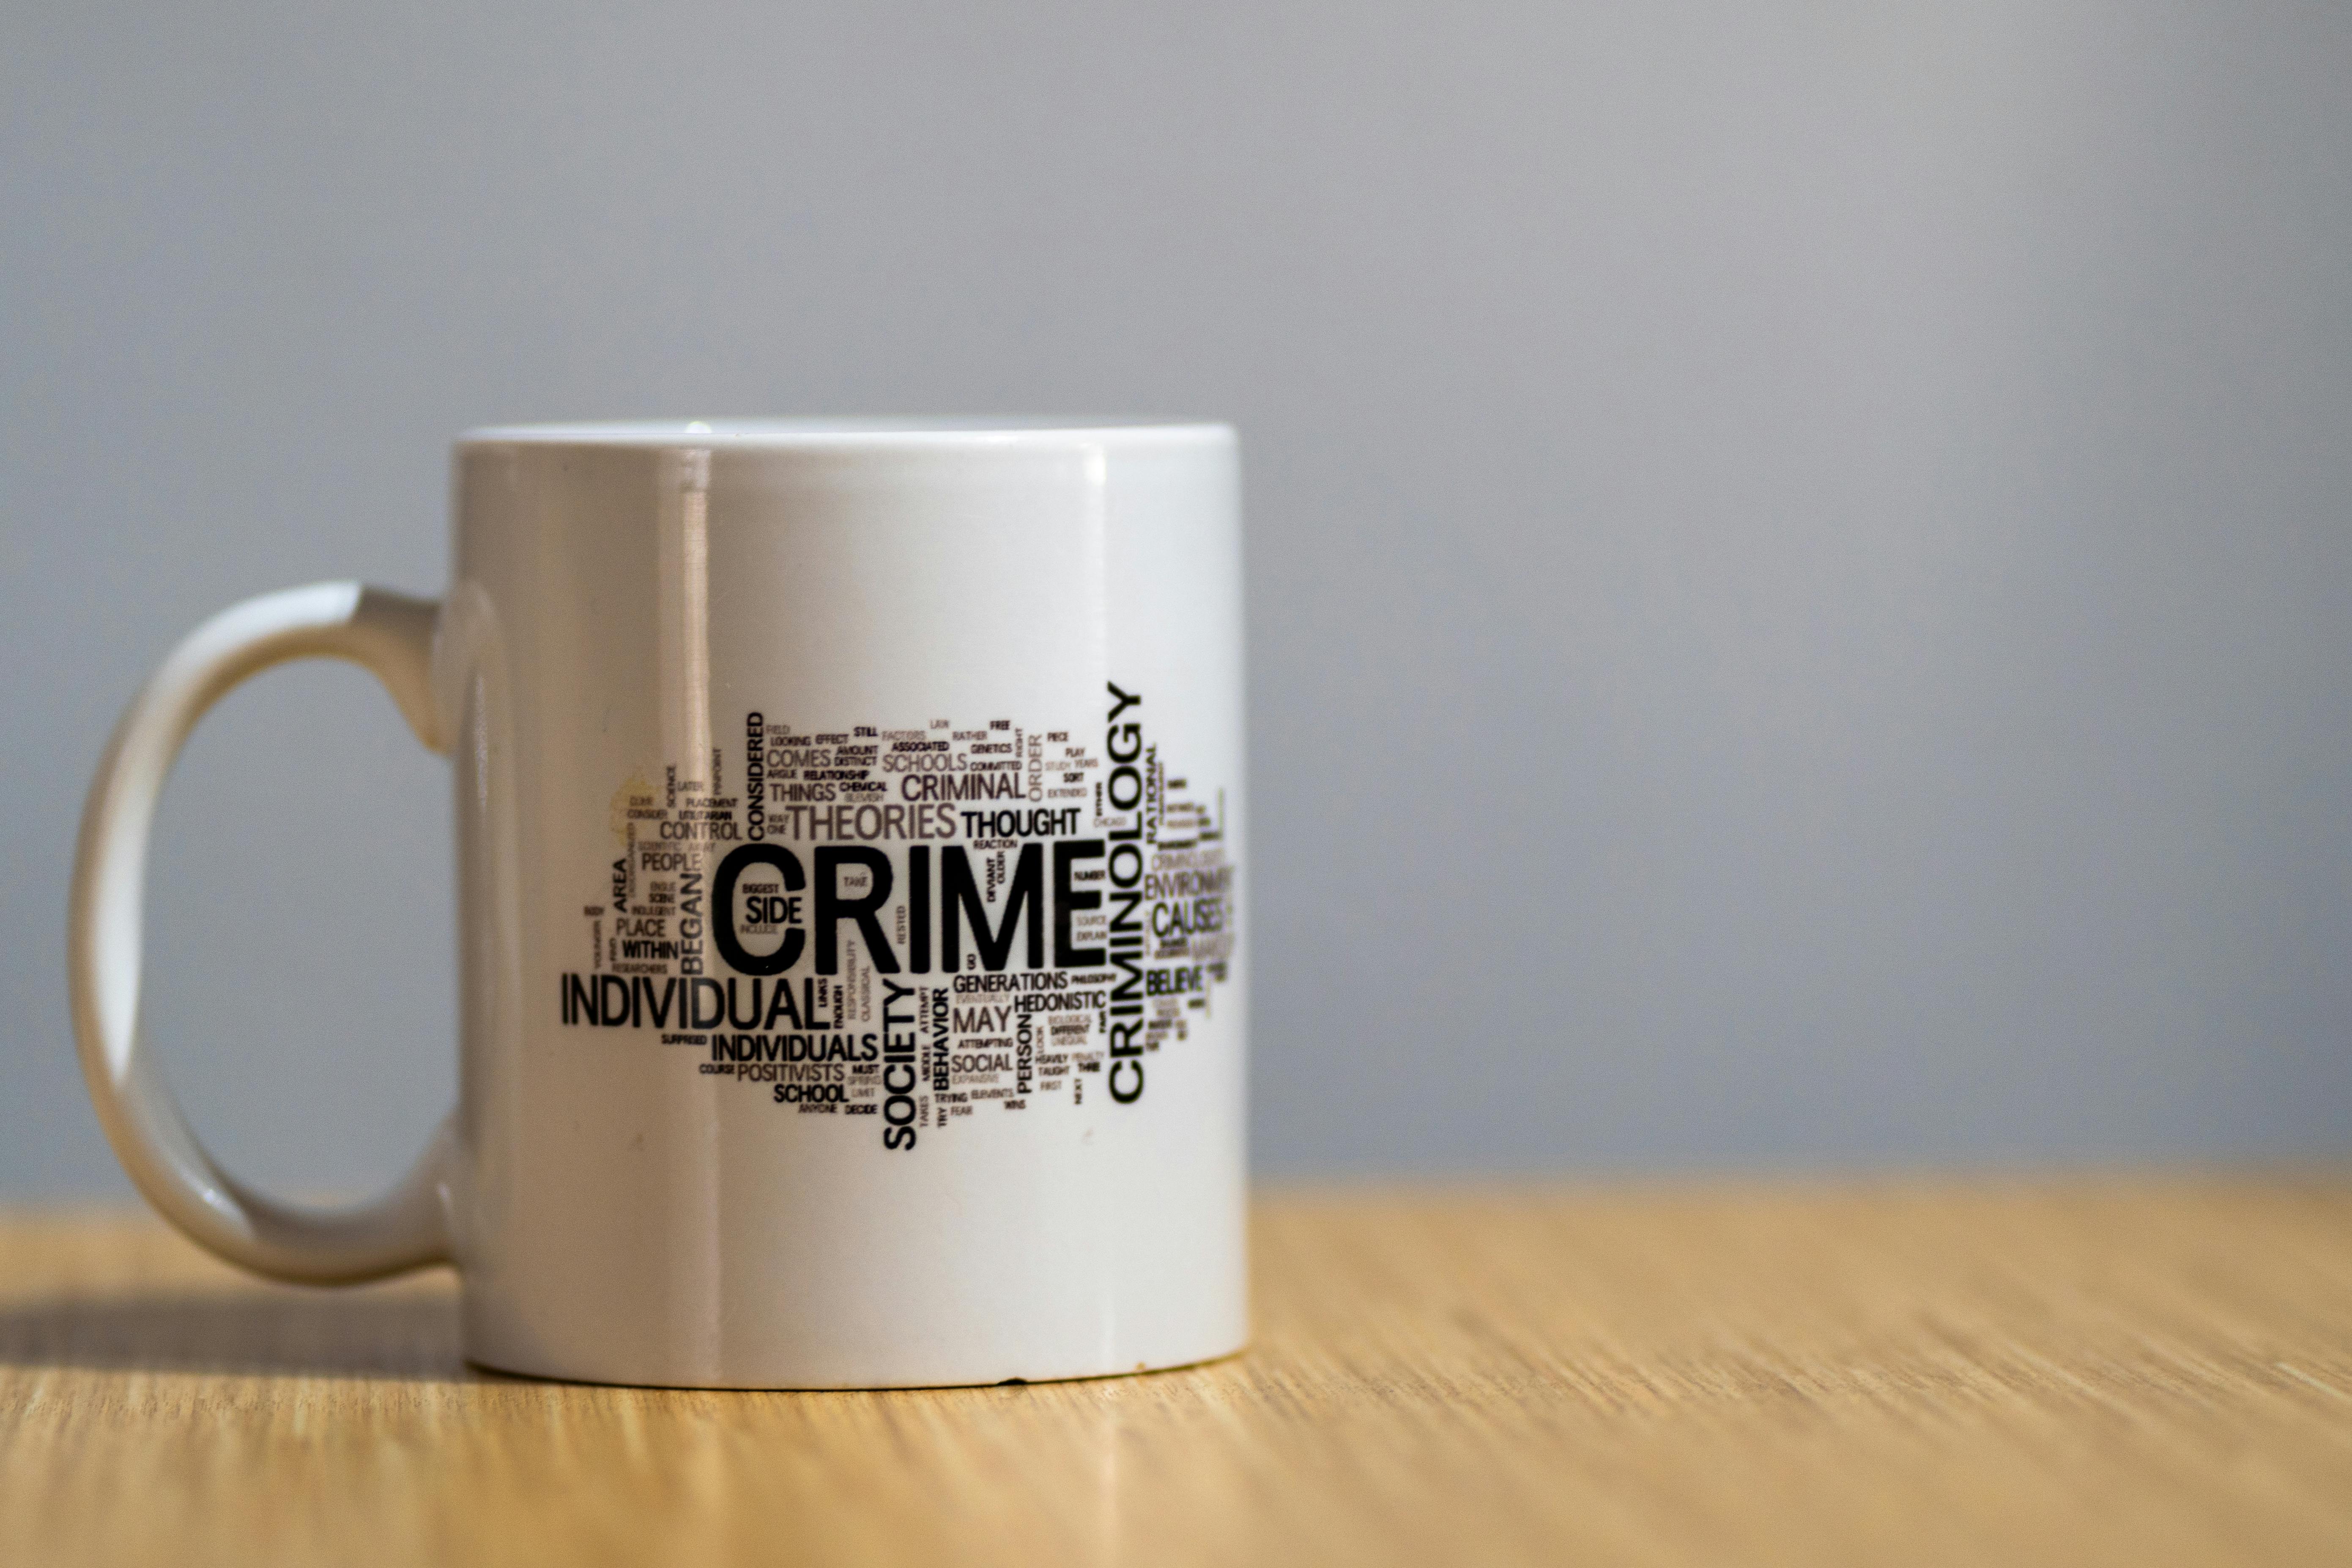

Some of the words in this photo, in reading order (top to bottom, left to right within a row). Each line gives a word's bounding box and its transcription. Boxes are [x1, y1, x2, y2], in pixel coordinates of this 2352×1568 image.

[854, 727, 878, 737] STILL
[990, 720, 1010, 731] FREE
[771, 735, 811, 746] LOOKING
[816, 734, 849, 744] EFFECT
[952, 731, 988, 741] RATHER
[1015, 727, 1024, 758] RIGHT
[1047, 731, 1069, 742] PIECE
[836, 745, 879, 755] AMOUNT
[891, 741, 949, 752] ASSOCIATED
[971, 743, 1013, 754] GENETICS
[1065, 747, 1086, 758] PLAY
[766, 749, 831, 768] COMES
[834, 756, 877, 766] DISTINCT
[882, 753, 967, 773] SCHOOLS
[970, 761, 1023, 772] COMMITTED
[1028, 733, 1042, 802] ORDER
[747, 712, 764, 841] CONSIDERED
[766, 769, 798, 779] ARGUE
[804, 770, 870, 780] RELATIONSHIP
[1063, 772, 1084, 783] SORT
[666, 764, 677, 808] SCIENCE
[678, 781, 703, 791] LATER
[770, 783, 836, 802] THINGS
[839, 782, 887, 792] CHEMICAL
[901, 772, 1026, 802] CRIMINAL
[1048, 788, 1087, 799] EXTENDED
[1145, 742, 1157, 844] RATIONAL
[686, 798, 738, 808] PLACEMENT
[679, 810, 732, 820] UTILITARIAN
[785, 803, 956, 840] THEORIES
[960, 808, 1081, 838] THOUGHT
[660, 821, 742, 840] CONTROL
[973, 839, 1018, 850] REACTION
[642, 852, 701, 871] PEOPLE
[997, 851, 1005, 884] OLDER
[986, 858, 996, 903] DEVIANT
[1073, 870, 1106, 881] NUMBER
[613, 858, 627, 913] AREA
[742, 884, 779, 894] BIGGEST
[1107, 680, 1144, 1104] CRIMINOLOGY
[712, 839, 1106, 976] CRIME
[746, 896, 802, 924] SIDE
[616, 918, 665, 937] PLACE
[679, 873, 703, 975] BEGAN
[622, 940, 679, 960] WITHIN
[846, 939, 856, 1020] RESPONSIBILITY
[953, 971, 1068, 993] GENERATIONS
[1071, 973, 1117, 985] PHILOSOPHY
[1146, 965, 1203, 996] BELIEVE
[562, 973, 830, 1030] INDIVIDUAL
[819, 978, 827, 1007] LINKS
[862, 966, 870, 1022] CLASSICAL
[1014, 990, 1106, 1012] HEDONISTIC
[834, 985, 843, 1029] ENOUGH
[920, 986, 929, 1033] ATTEMPT
[953, 1006, 1012, 1033] MAY
[933, 987, 949, 1091] BEHAVIOR
[1051, 1024, 1090, 1035] DIFFERENT
[712, 1033, 878, 1062] INDIVIDUALS
[958, 1037, 1013, 1049] ATTEMPTING
[921, 1045, 931, 1082] MIDDLE
[951, 1054, 1013, 1073] SOCIAL
[1016, 1014, 1032, 1094] PERSON
[1036, 1053, 1069, 1064] HEAVILY
[700, 1064, 735, 1074] COURSE
[737, 1064, 845, 1082] POSITIVISTS
[852, 1064, 880, 1074] MUST
[883, 978, 916, 1151] SOCIETY
[1038, 1065, 1070, 1076] TAUGHT
[774, 1084, 849, 1103] SCHOOL
[935, 1093, 967, 1103] TRYING
[799, 1104, 837, 1113] ANYONE
[845, 1104, 878, 1114] DECIDE
[920, 1096, 929, 1127] TAKES
[937, 1107, 947, 1128] TRY
[950, 1106, 973, 1116] FEAR
